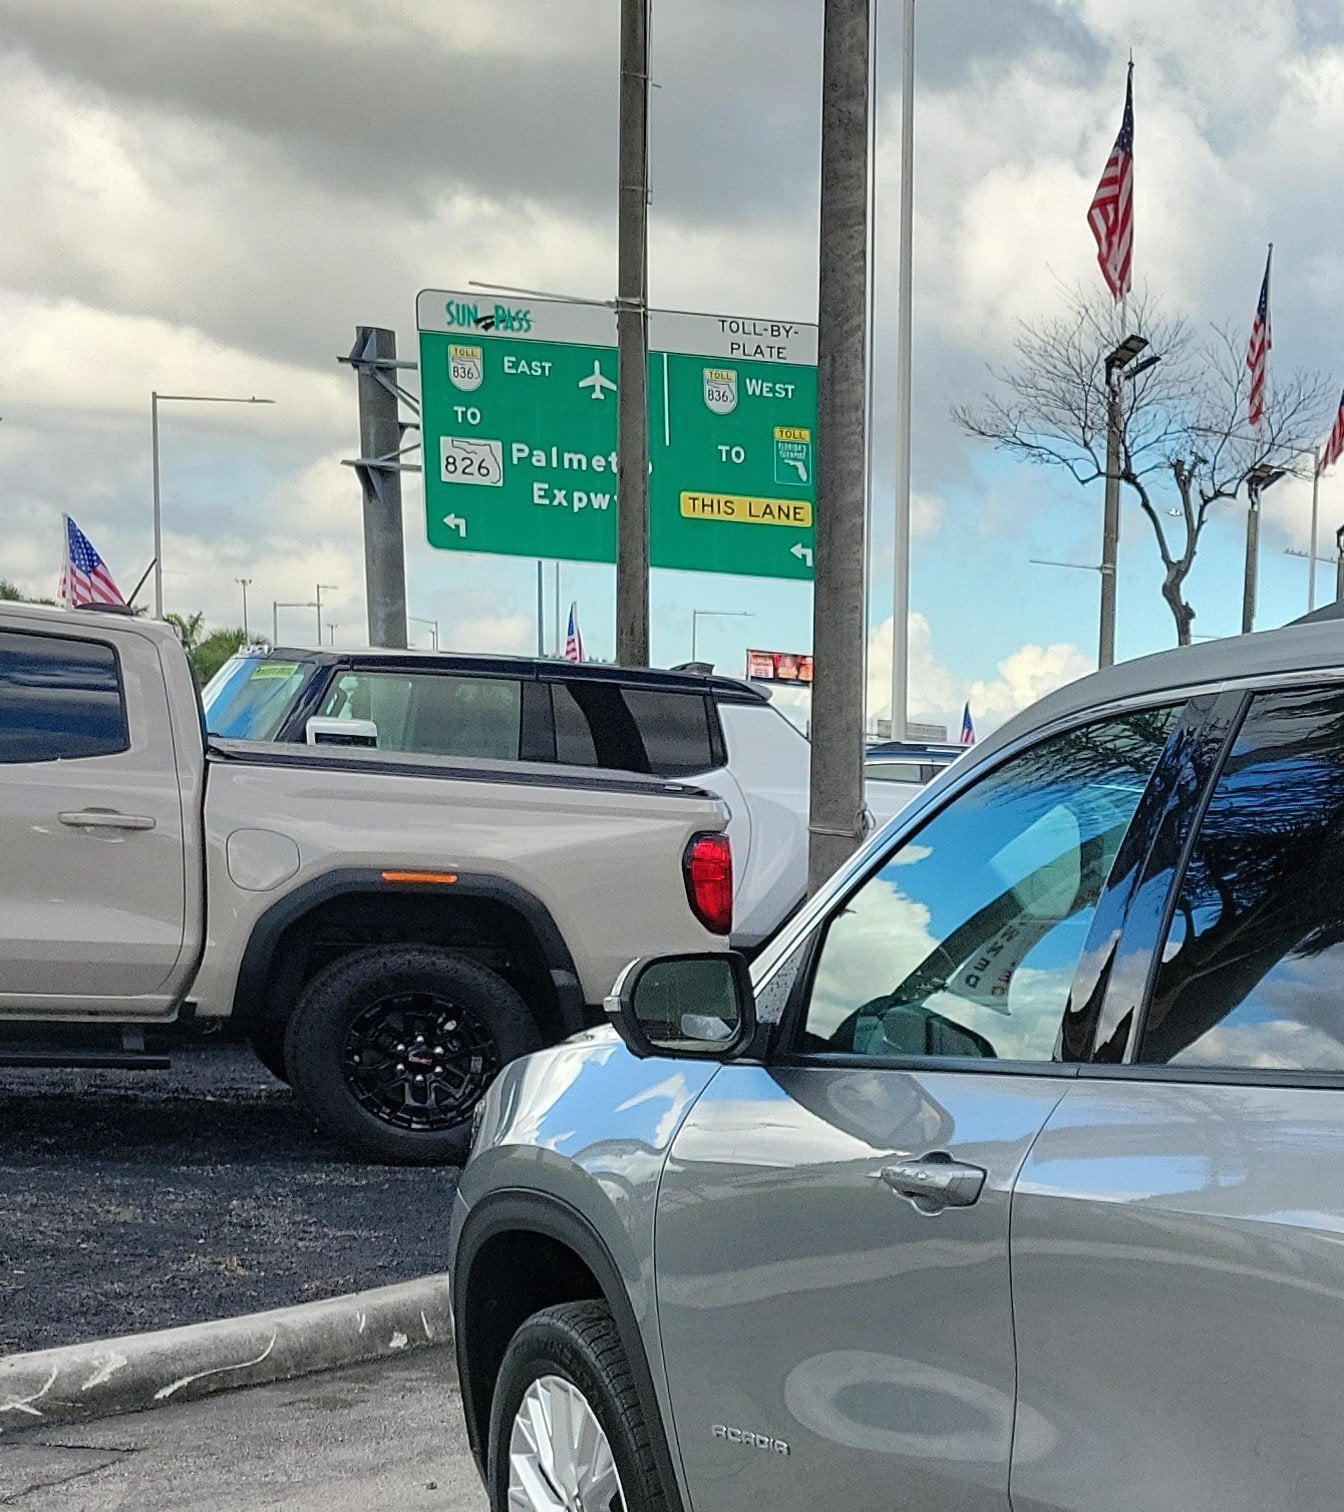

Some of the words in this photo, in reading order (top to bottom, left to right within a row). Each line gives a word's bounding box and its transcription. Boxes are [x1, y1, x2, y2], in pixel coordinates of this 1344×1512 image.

[718, 319, 800, 339] TOLL-BY-
[453, 347, 477, 358] TOLL
[730, 342, 788, 361] PLATE
[452, 366, 475, 380] 836
[503, 355, 553, 377] EAST
[708, 371, 733, 381] TOLL
[707, 389, 729, 403] 836
[745, 378, 796, 399] WEST
[453, 405, 482, 425] TO
[779, 429, 806, 440] TOLL
[717, 444, 745, 464] TO
[444, 455, 491, 478] 826
[532, 481, 618, 513] Expw
[688, 496, 736, 516] THIS
[748, 501, 806, 522] LANE
[711, 1424, 791, 1456] ACADIA
